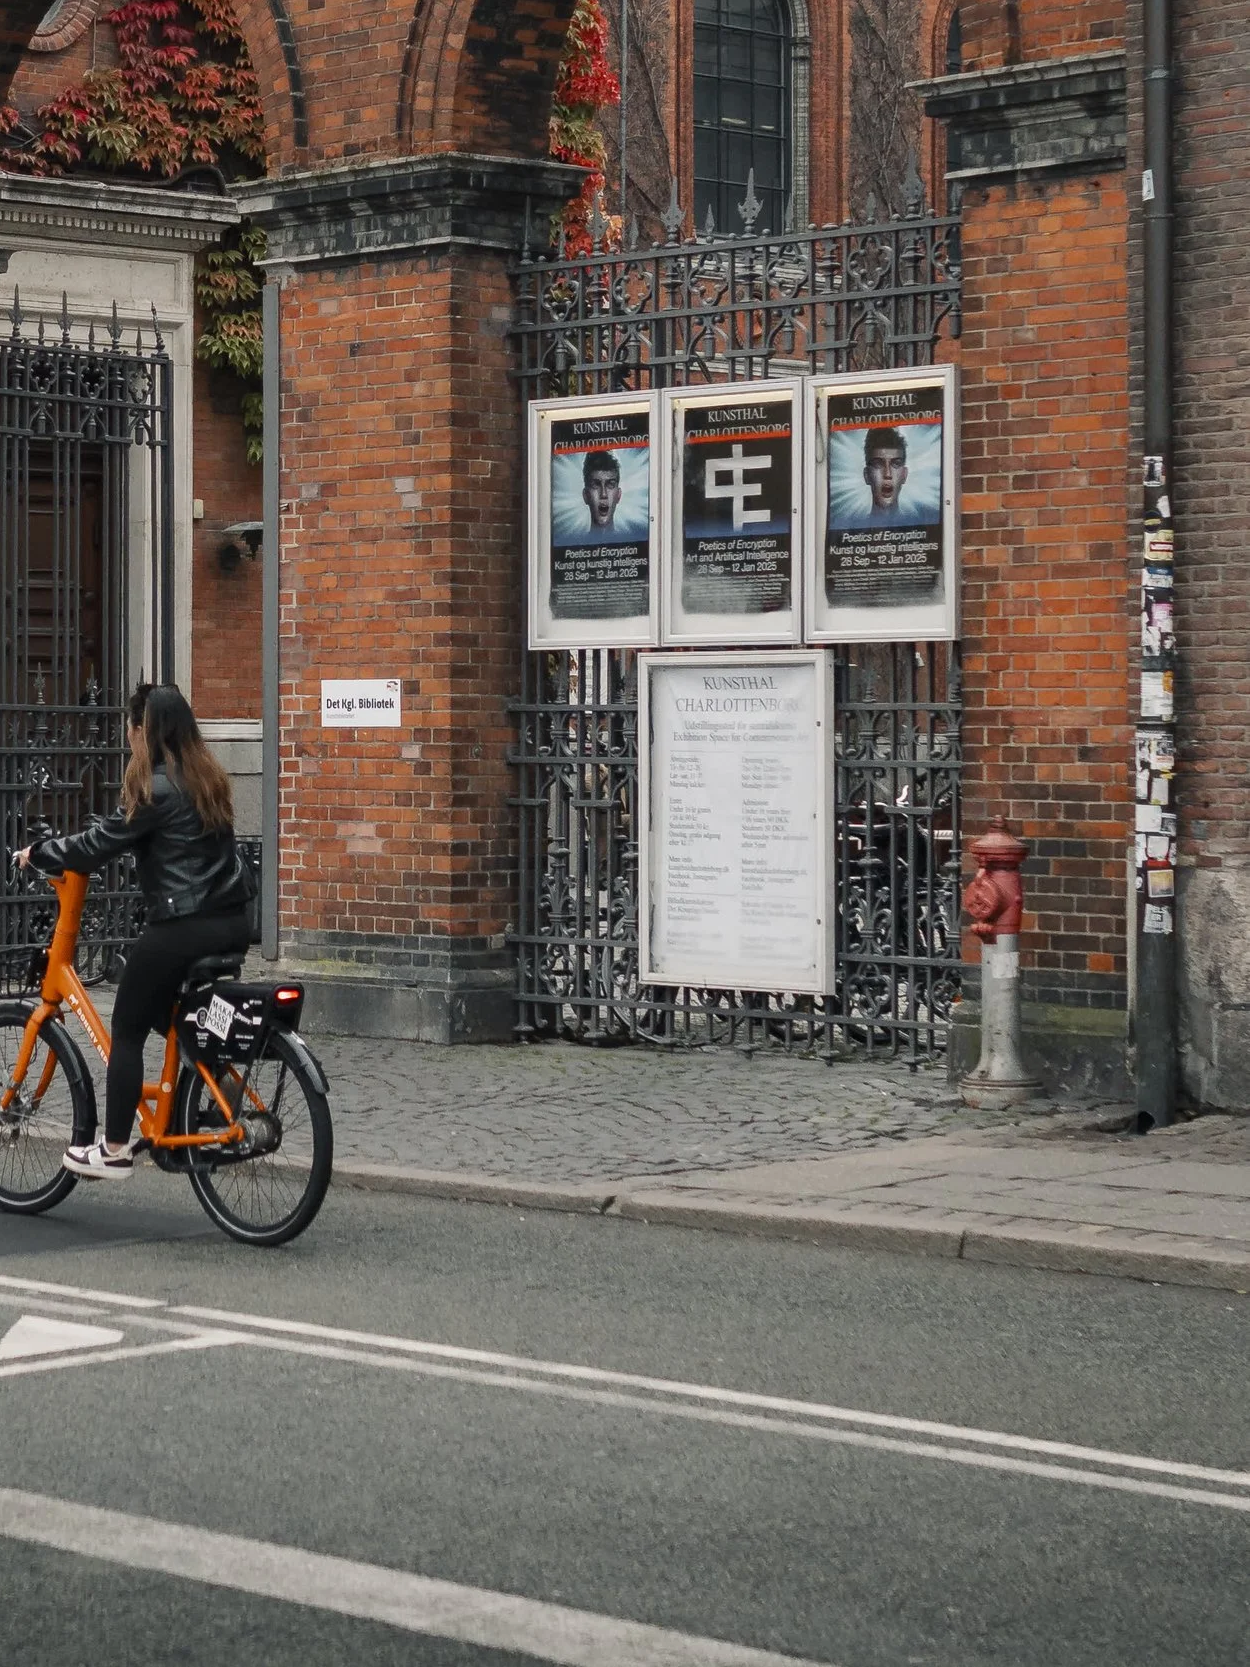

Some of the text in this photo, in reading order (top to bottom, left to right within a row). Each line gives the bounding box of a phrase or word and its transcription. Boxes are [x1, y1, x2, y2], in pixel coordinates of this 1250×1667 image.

[852, 394, 916, 410] KUNSTHAL
[708, 407, 767, 422] KUNSTHAL
[574, 420, 628, 435] KUNSTHAL
[842, 530, 926, 542] Poetics of Encryption
[698, 538, 777, 550] Poetics of Encryption
[830, 542, 938, 555] Kunst og kunstig intelligens
[565, 546, 638, 558] Poetics of Encryption
[686, 550, 789, 563] Art and Artificial Intelligence
[555, 558, 648, 571] Kunst og kunstig intelligens
[840, 557, 852, 566] 28
[854, 556, 870, 567] Sep
[878, 556, 886, 565] 12
[888, 555, 904, 564] Jan
[904, 553, 927, 564] 2025
[564, 572, 574, 581] 28
[575, 570, 589, 582] Sep
[596, 570, 604, 579] 12
[605, 570, 618, 579] Jan
[619, 568, 638, 578] 2025
[708, 564, 724, 574] Sep
[732, 564, 740, 572] 12
[741, 563, 756, 572] Jan
[756, 562, 777, 572] 2025
[702, 676, 778, 690] KUNSTHAL
[326, 698, 394, 712] Det Kgl. Bibliotek
[77, 1008, 98, 1043] DONKEY
